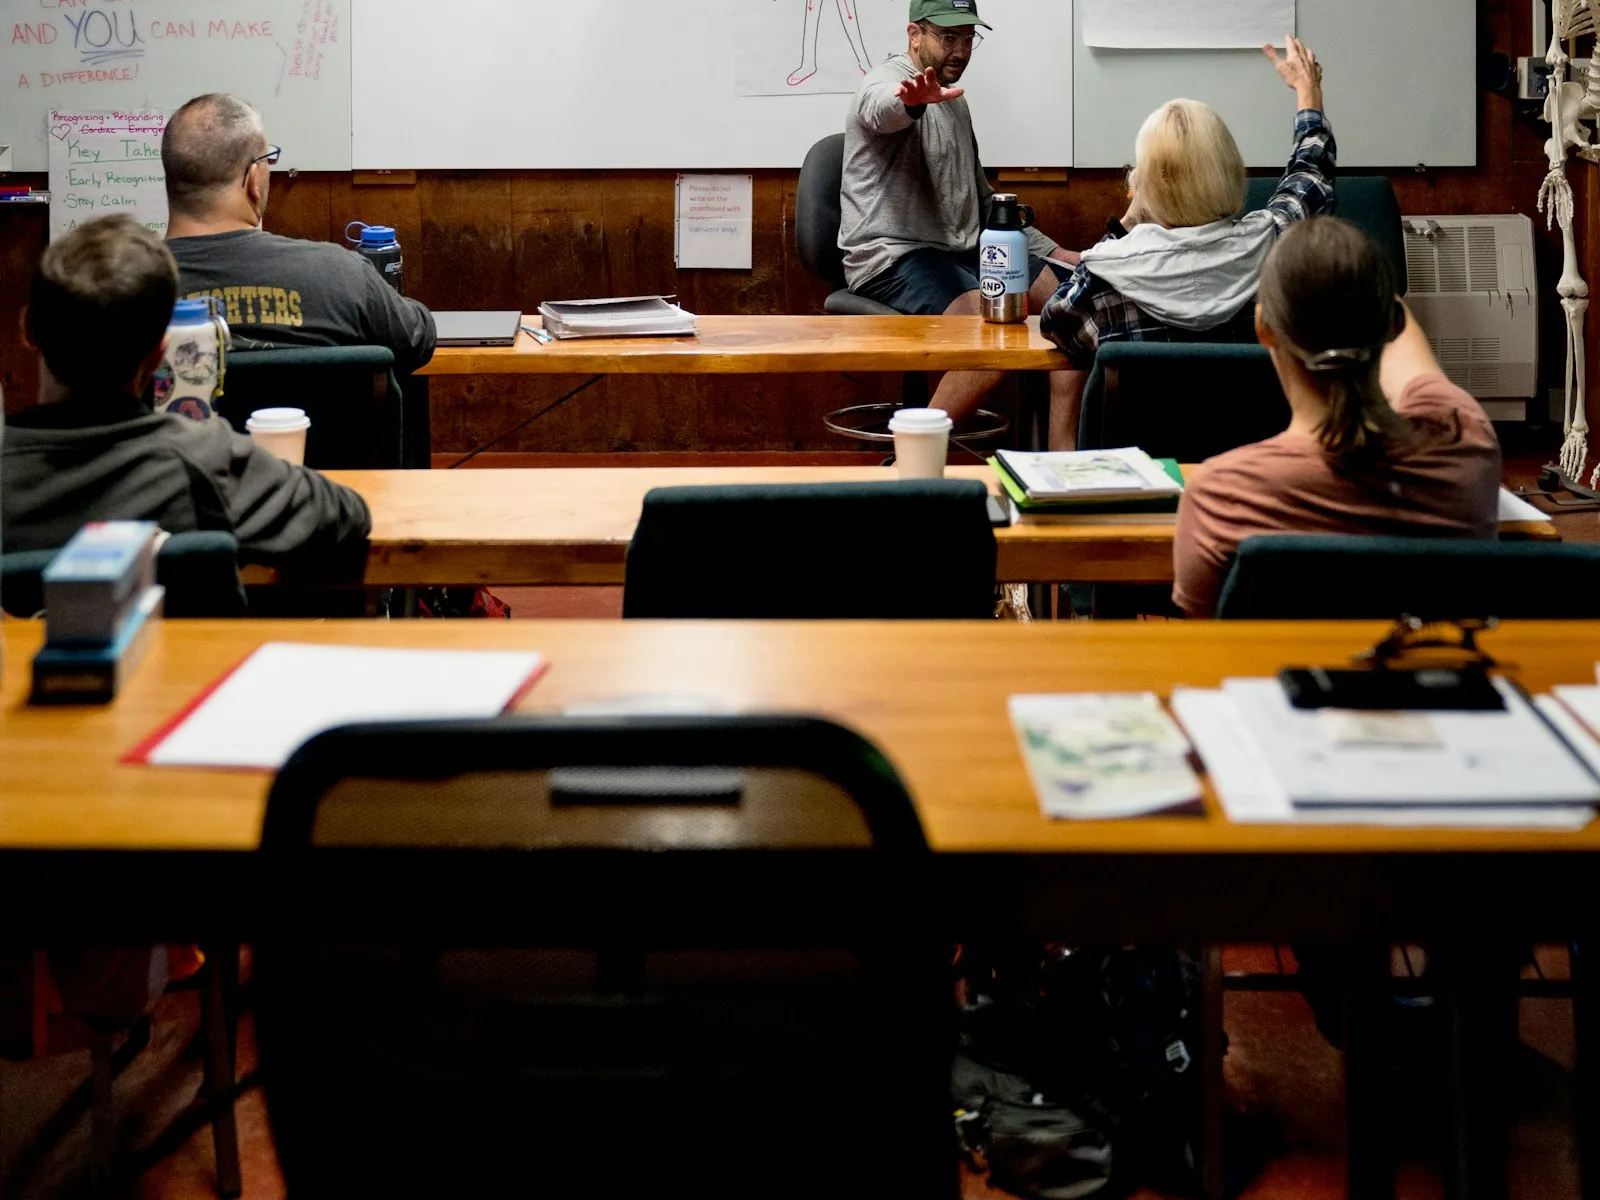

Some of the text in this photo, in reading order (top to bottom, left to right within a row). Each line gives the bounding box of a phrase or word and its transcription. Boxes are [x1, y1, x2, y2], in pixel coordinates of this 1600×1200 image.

[11, 10, 274, 48] AND YOU CAN MAKE
[18, 63, 140, 89] A DIFFERENCE!
[50, 111, 104, 125] Recognizing
[112, 111, 164, 125] Responding
[68, 139, 100, 163] Key
[68, 168, 101, 188] Early
[66, 193, 137, 210] Stay Calm
[982, 281, 1001, 291] ANP
